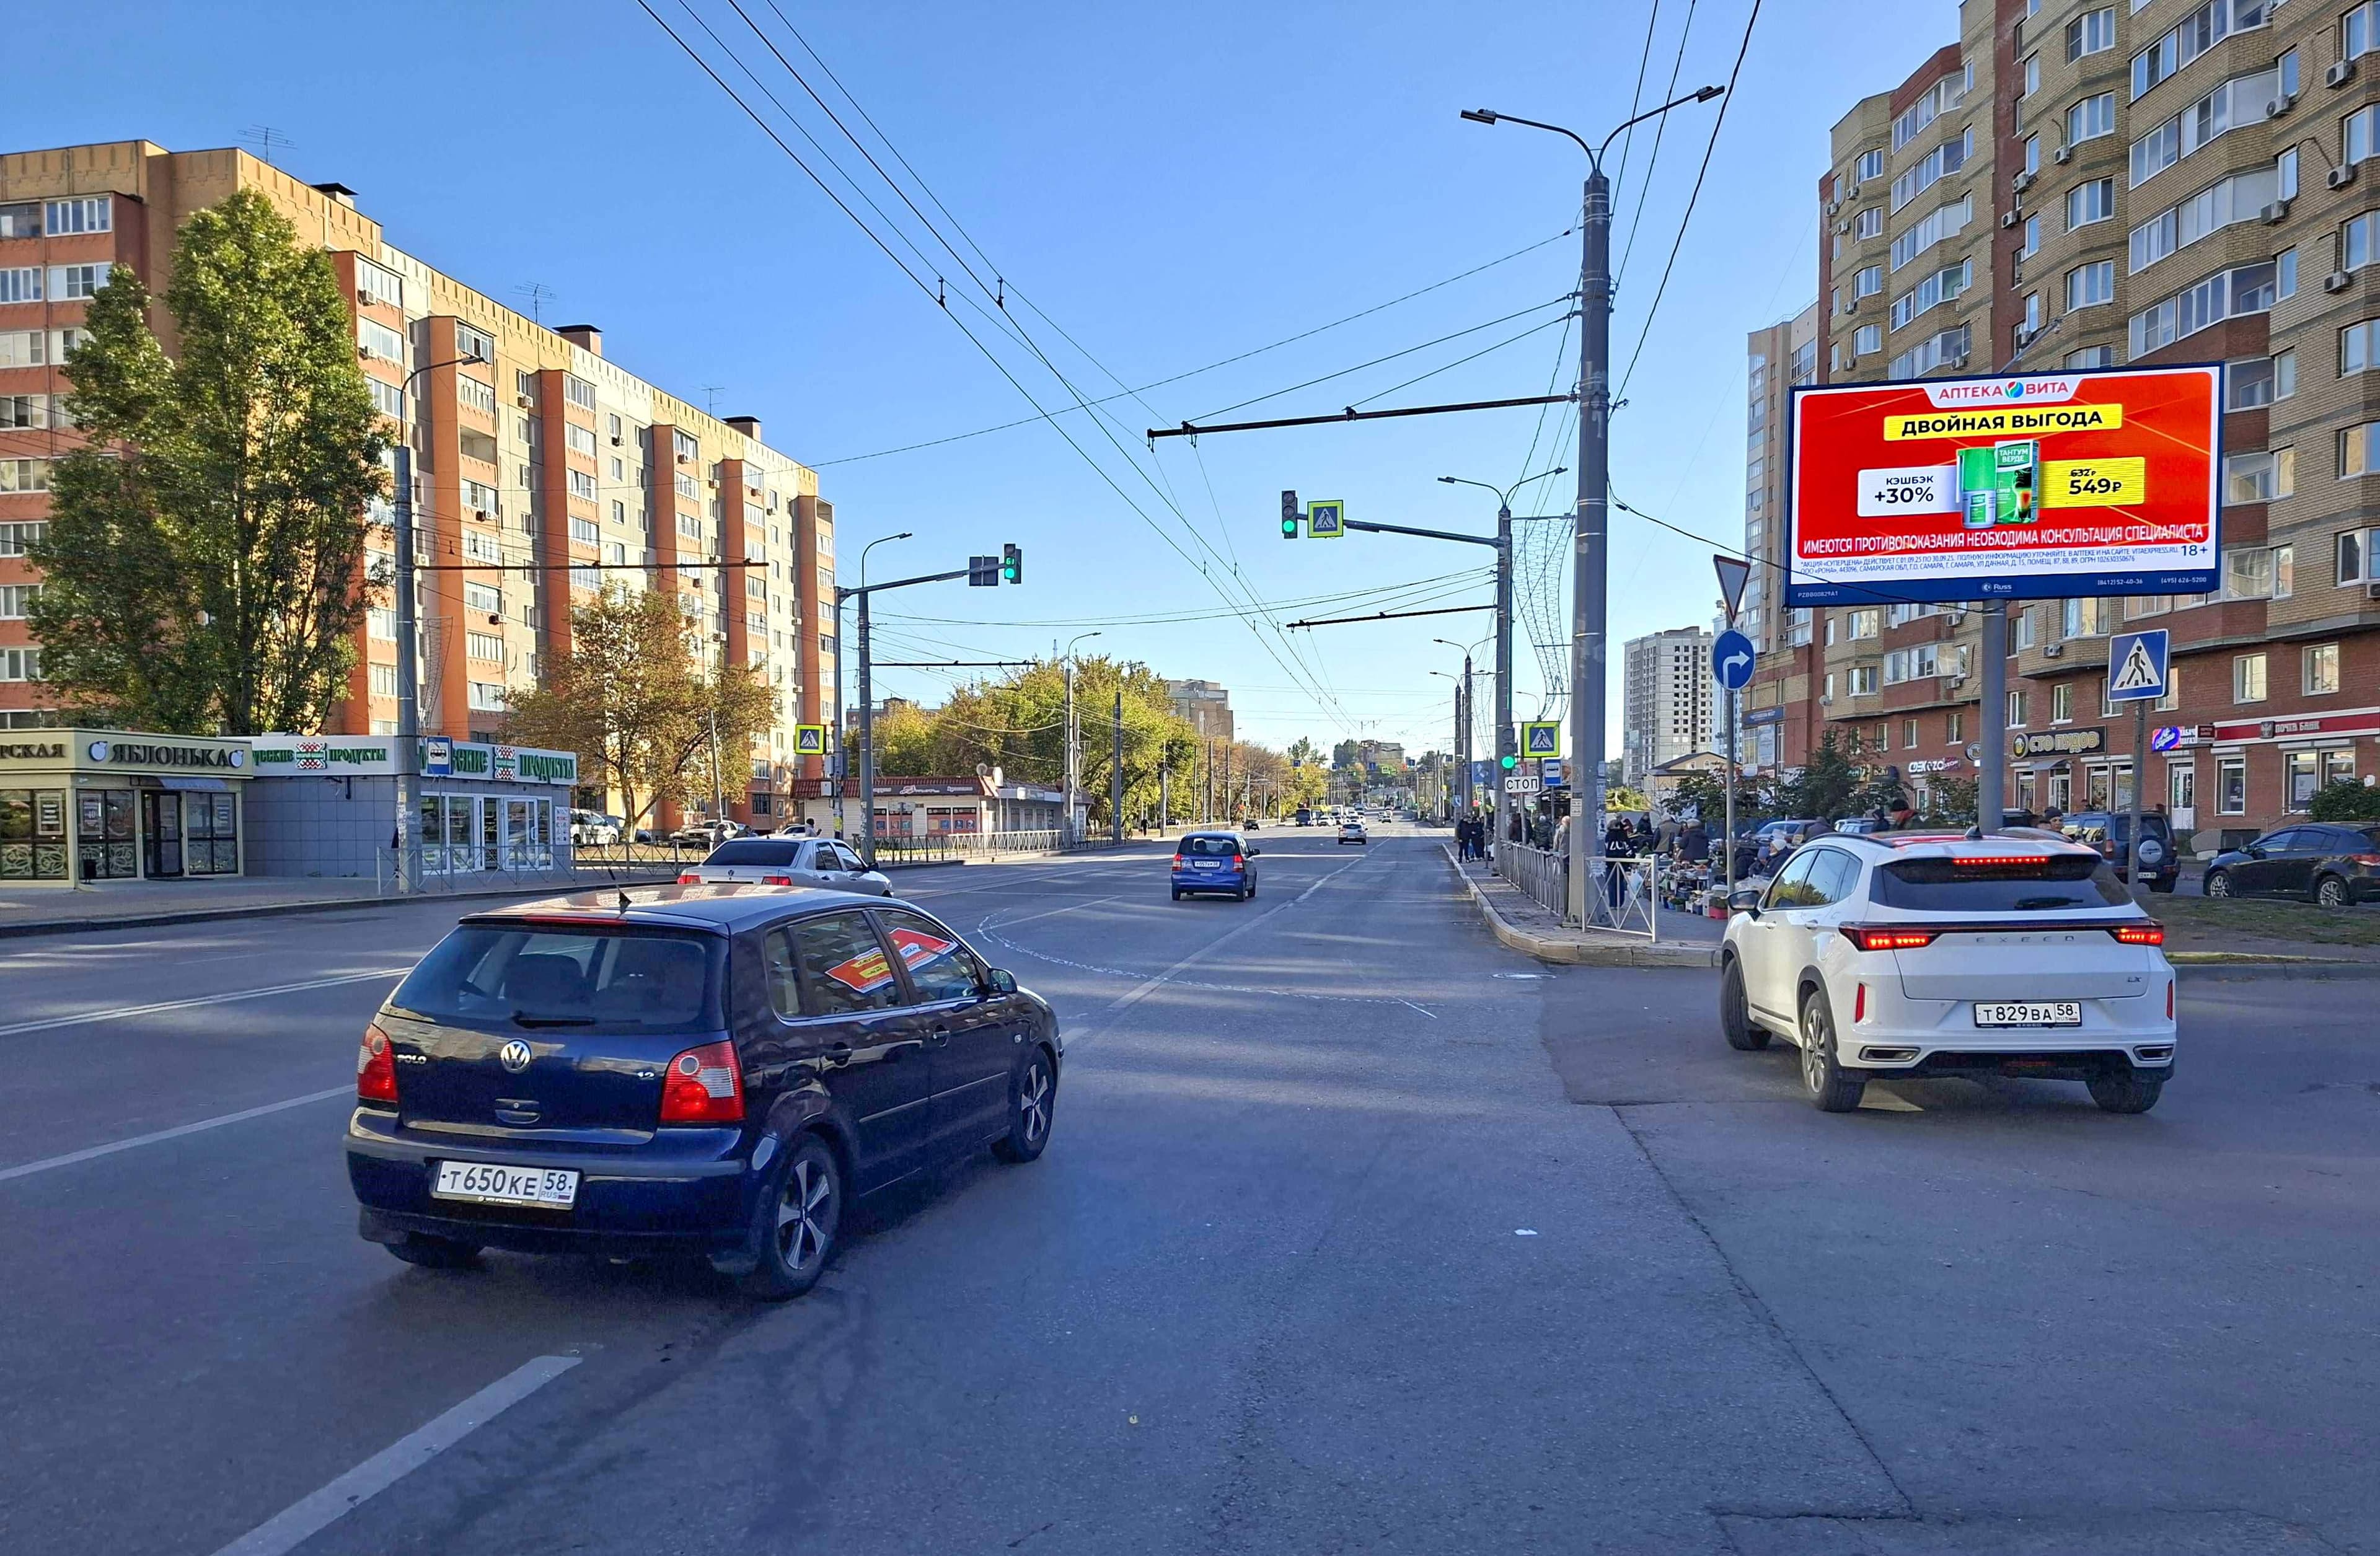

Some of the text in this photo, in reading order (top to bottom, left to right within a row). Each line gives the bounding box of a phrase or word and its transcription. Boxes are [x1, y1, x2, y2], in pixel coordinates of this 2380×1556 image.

[1939, 382, 2069, 400] АПТЕКА ВИТА
[1902, 411, 2103, 436] ДВОЙНАЯ ВЫГОДА
[1999, 448, 2029, 457] ТАНТУМ
[2002, 455, 2025, 463] ВЕРДЕ
[1886, 475, 1934, 485] КЭШБЭК
[1874, 486, 1934, 504] +30%
[1803, 523, 2203, 554] ИМЕЮТСЯ ПРОТИВОПОКАЗАНИЯ НЕОБХОДИМА КОНСУЛЬТАЦИЯ СПЕЦИАЛИСТА
[2180, 545, 2208, 556] 18+
[2028, 731, 2100, 754] СТО ПУДОВ
[110, 743, 230, 767] ЯБЛОНЬКА
[252, 750, 294, 766] УССКИЕ
[328, 748, 387, 765] ПРОДУКТЫ
[519, 754, 575, 784] ПРОДУКТЫ
[1506, 778, 1538, 790] СТОП
[1976, 935, 2074, 943] EXEED
[1983, 1004, 2074, 1021] Т829ВА 58
[397, 1054, 427, 1065] POLO
[449, 1167, 568, 1197] Т650КЕ 58
[540, 1190, 558, 1200] RUS
